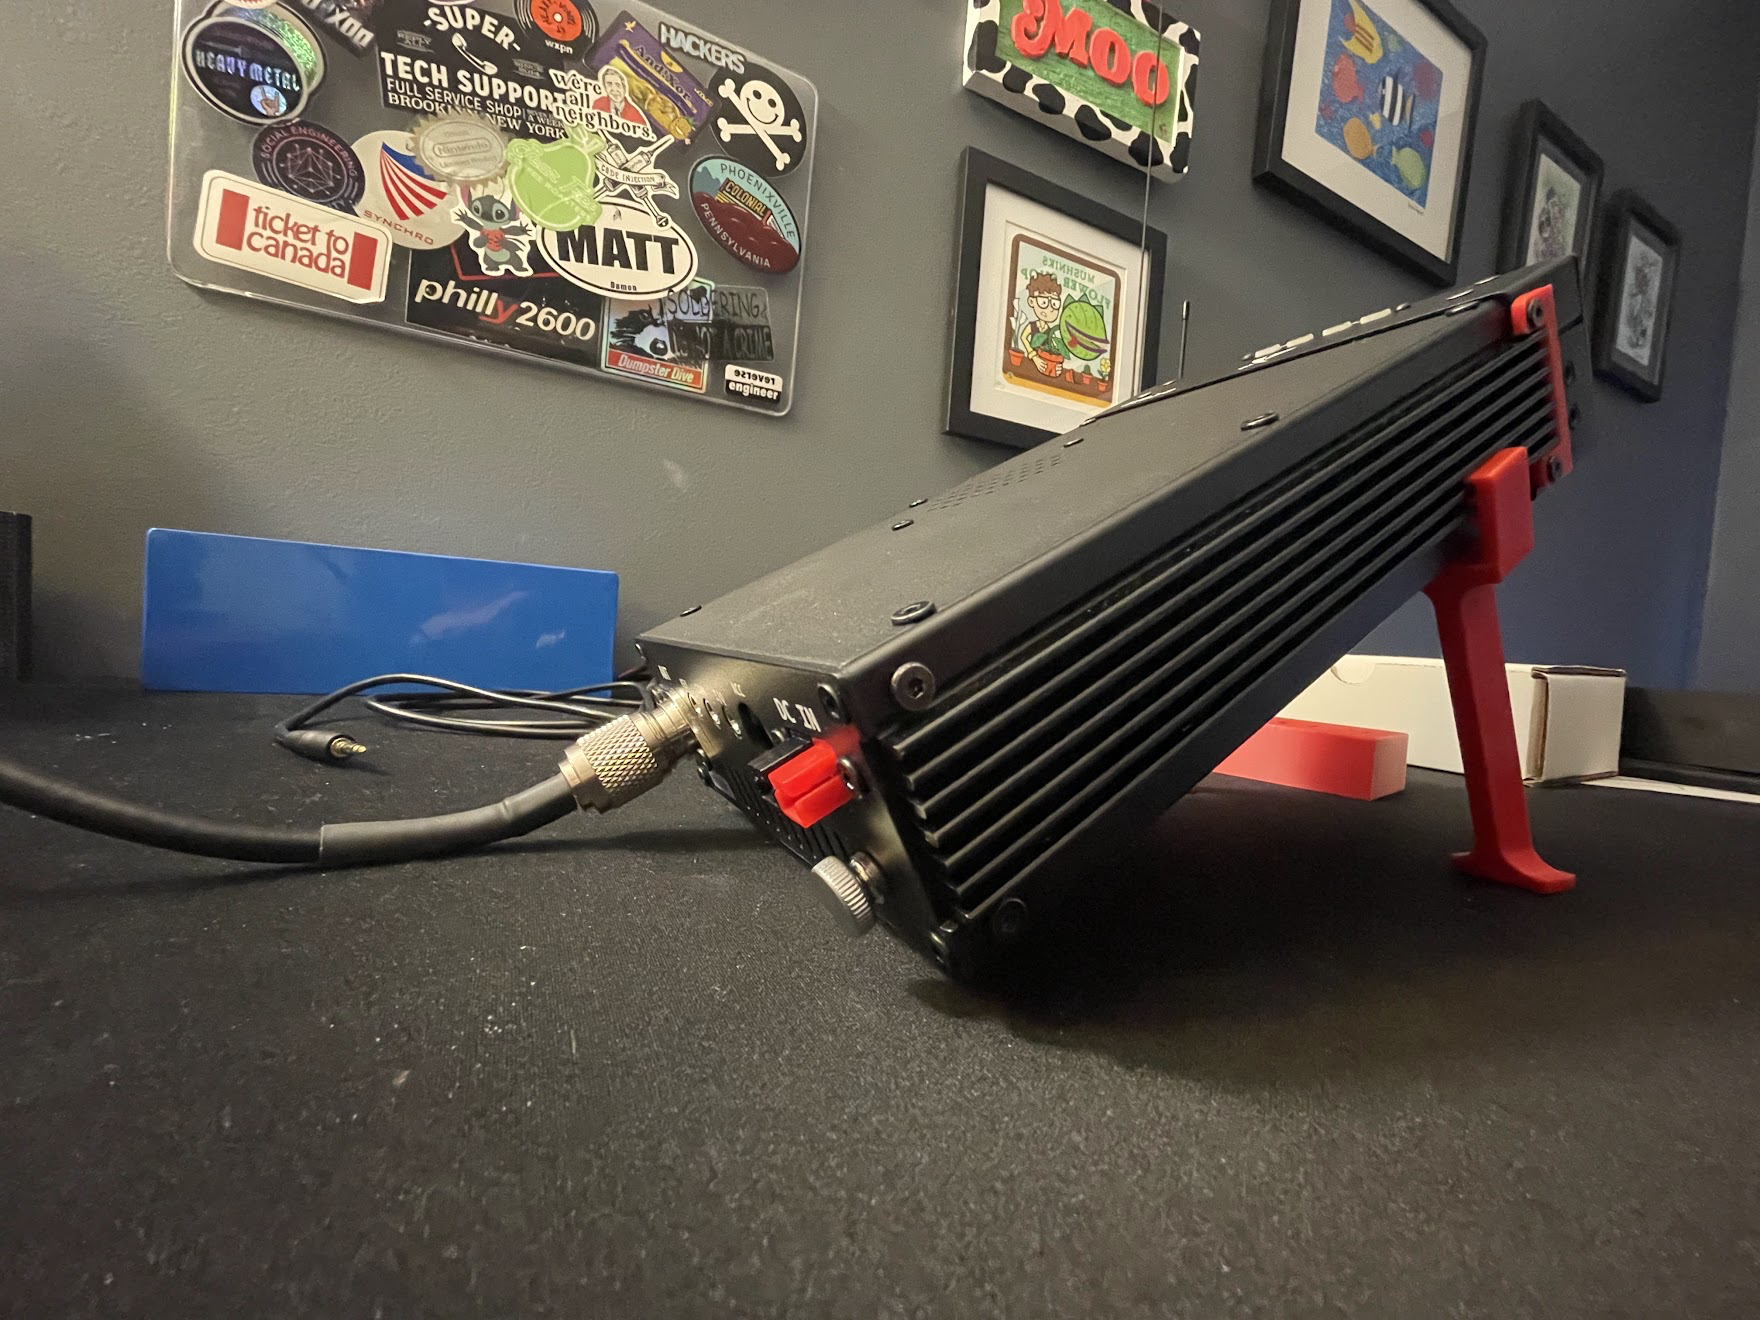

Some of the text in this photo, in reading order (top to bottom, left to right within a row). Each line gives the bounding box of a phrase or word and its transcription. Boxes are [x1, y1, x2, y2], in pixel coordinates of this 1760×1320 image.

[661, 23, 745, 74] HACKERS
[249, 62, 300, 91] METAL
[380, 51, 565, 112] TECH SUPPORT
[386, 77, 522, 119] FULL SERVICE SHOP
[570, 92, 590, 109] all
[485, 113, 522, 131] NEW
[526, 121, 566, 139] YORK
[260, 126, 358, 177] SOCIAL ENGINEERING
[438, 142, 488, 155] Nintendo
[601, 164, 619, 179] CODE
[622, 173, 655, 183] INJECTION
[720, 163, 796, 239] PHOENIXVILLE
[725, 181, 766, 215] COLONIAL
[253, 204, 349, 255] ticket to
[363, 210, 434, 245] SYNCHRO
[701, 203, 771, 268] PENNSYLVANIA
[247, 230, 346, 279] canada
[556, 225, 679, 275] MATT
[610, 281, 637, 292] Damon
[617, 353, 694, 384] Dumpster Dive
[728, 382, 779, 400] engineer
[773, 697, 822, 733] DC IN
